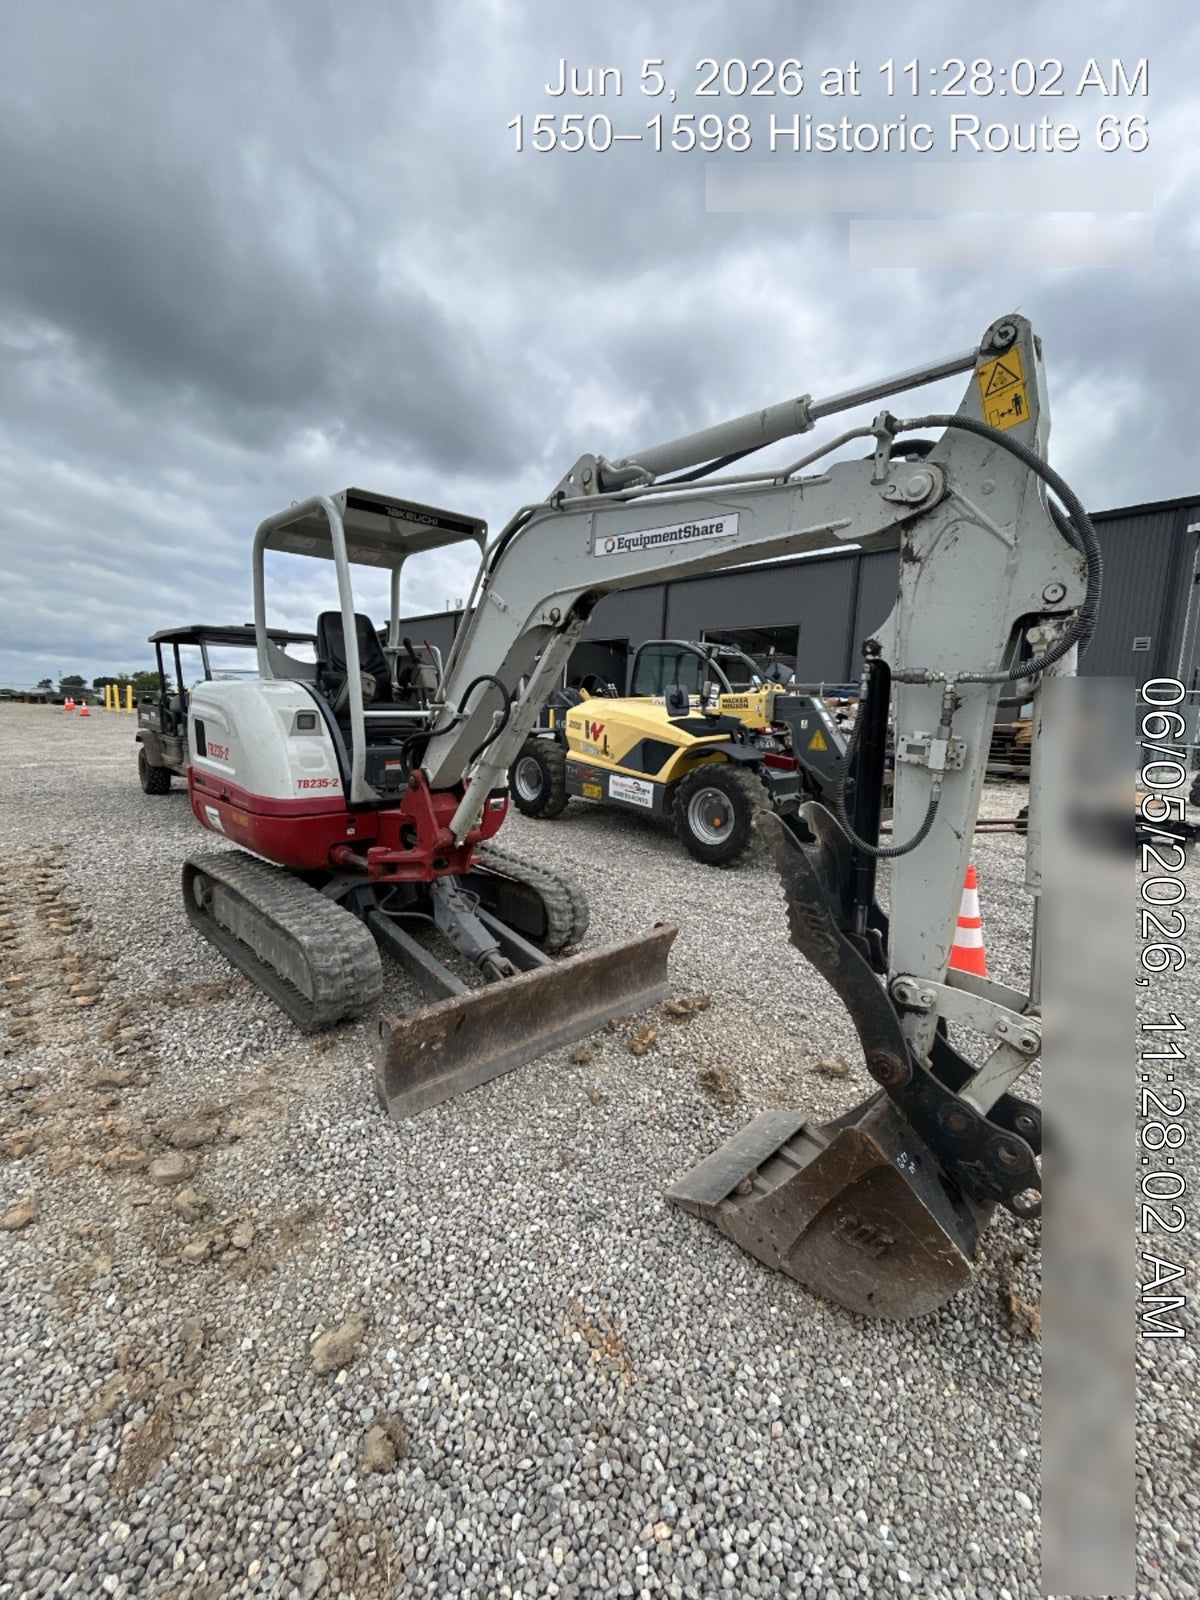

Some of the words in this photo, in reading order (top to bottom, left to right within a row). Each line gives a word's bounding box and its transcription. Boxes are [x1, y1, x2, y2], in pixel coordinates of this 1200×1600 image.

[385, 506, 439, 526] TAKEUCHI
[616, 521, 724, 550] EquipmentShare
[297, 778, 339, 789] TB235-2
